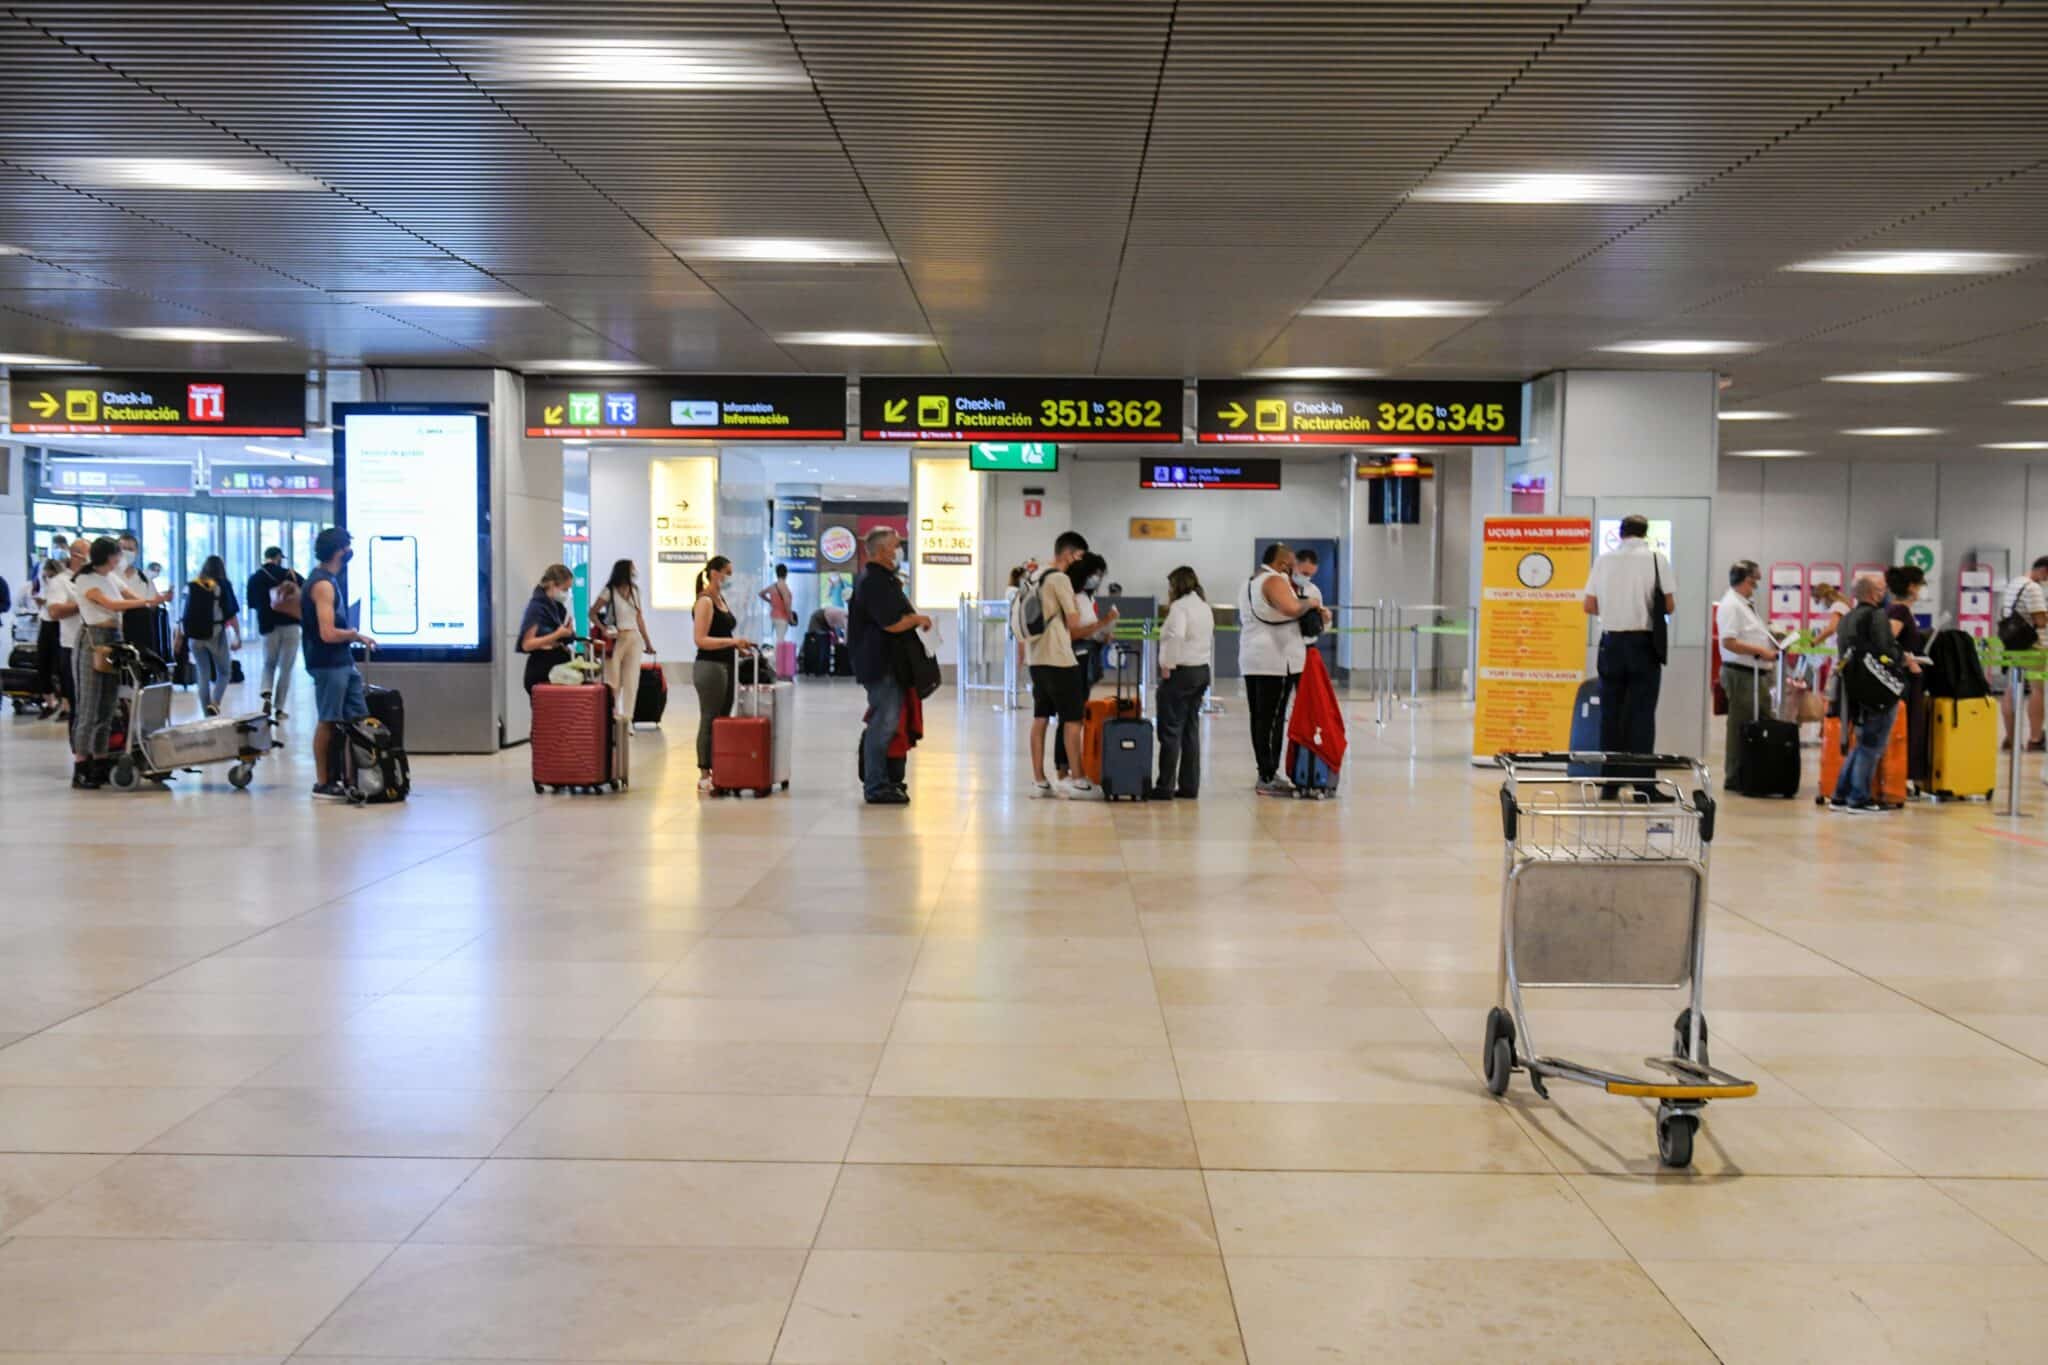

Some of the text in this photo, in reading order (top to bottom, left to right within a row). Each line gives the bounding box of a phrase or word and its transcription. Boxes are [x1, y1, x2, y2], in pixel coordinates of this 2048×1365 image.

[103, 391, 153, 405] Check-in
[189, 392, 224, 418] T1
[955, 397, 1006, 411] Check-in
[103, 406, 180, 421] Facturación
[571, 401, 599, 421] T2
[607, 401, 635, 422] T3
[723, 402, 774, 413] Information
[1040, 399, 1091, 427] 351
[1105, 399, 1162, 428] 362
[1093, 401, 1105, 414] to
[1294, 401, 1344, 415] Check-in
[1435, 405, 1448, 418] to
[723, 413, 789, 425] Información
[955, 411, 1033, 427] Facturación
[1293, 415, 1371, 432] Facturación
[1377, 402, 1435, 432] 326
[1447, 402, 1505, 432] 345
